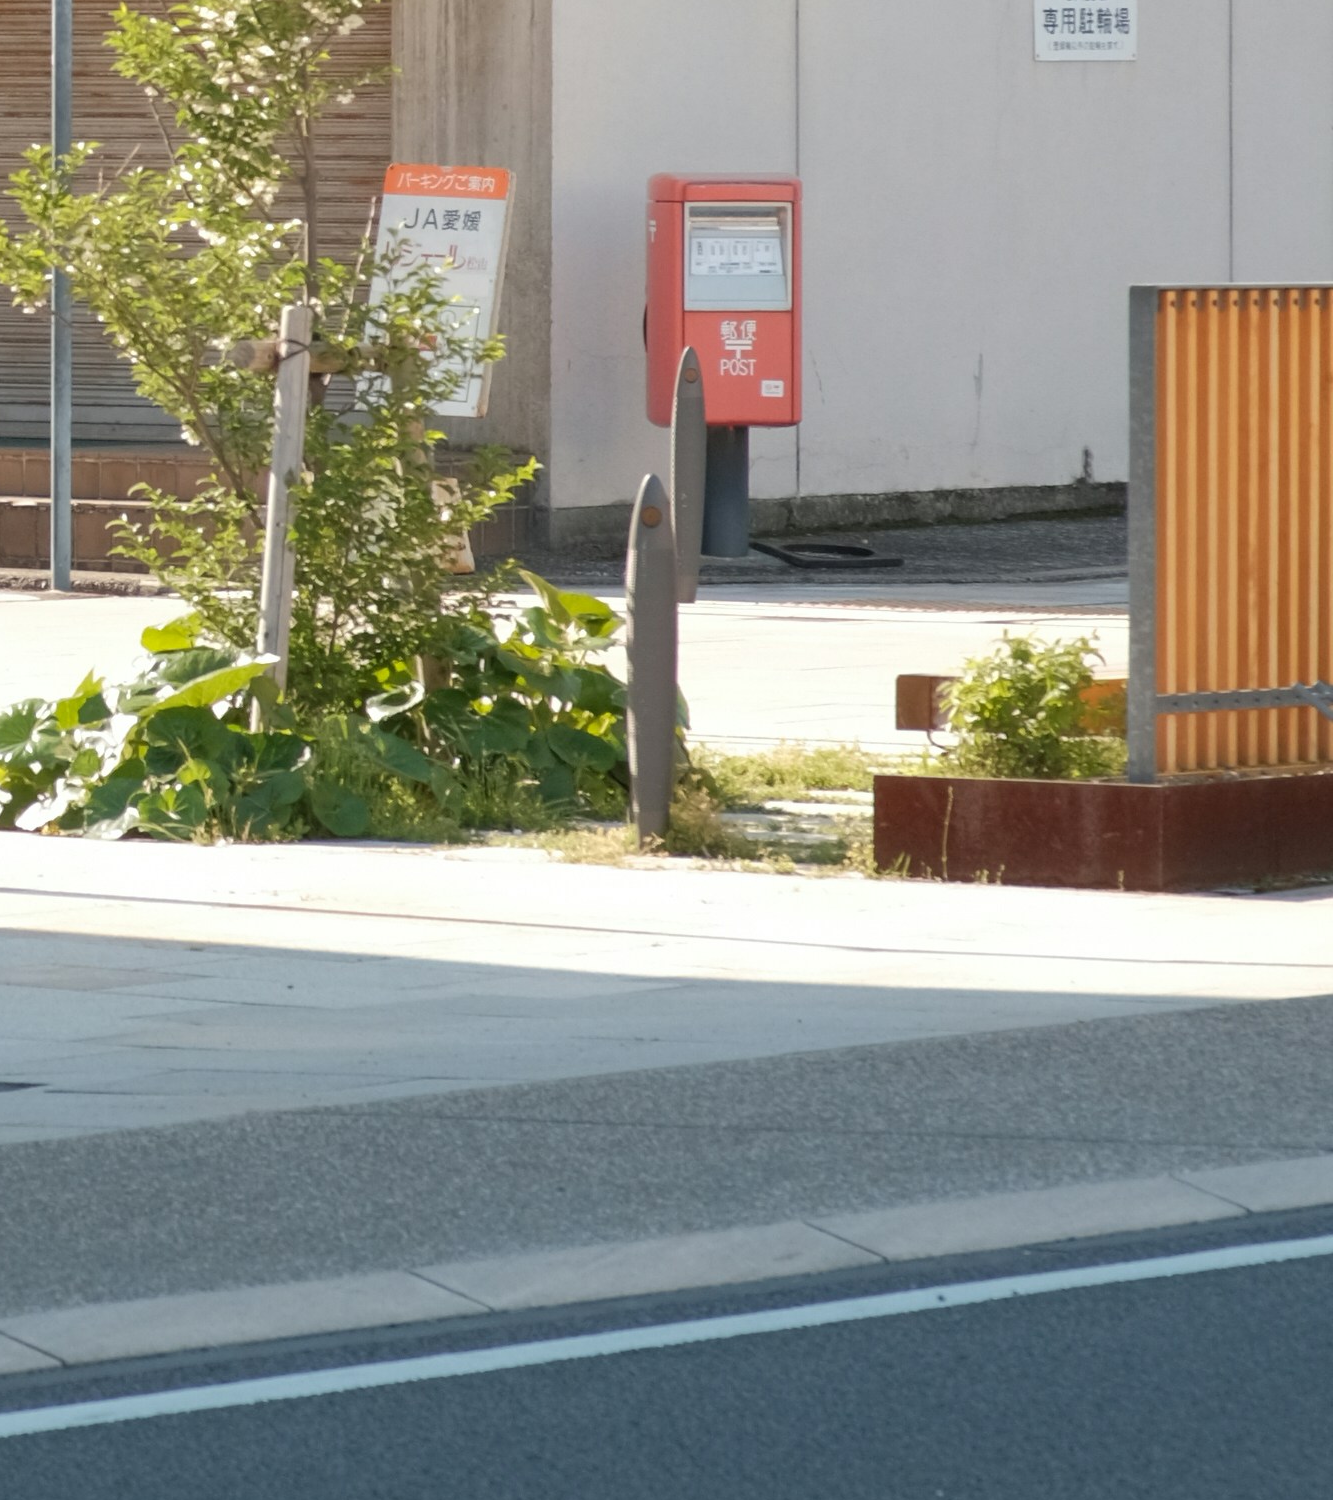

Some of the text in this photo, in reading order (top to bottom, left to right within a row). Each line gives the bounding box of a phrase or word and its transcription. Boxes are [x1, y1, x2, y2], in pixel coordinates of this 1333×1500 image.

[1043, 7, 1130, 34] 専用駐輪場
[396, 172, 495, 192] パーキングご案内
[404, 208, 482, 232] JA愛媛
[720, 320, 757, 340] 郵便
[720, 359, 757, 376] POST
